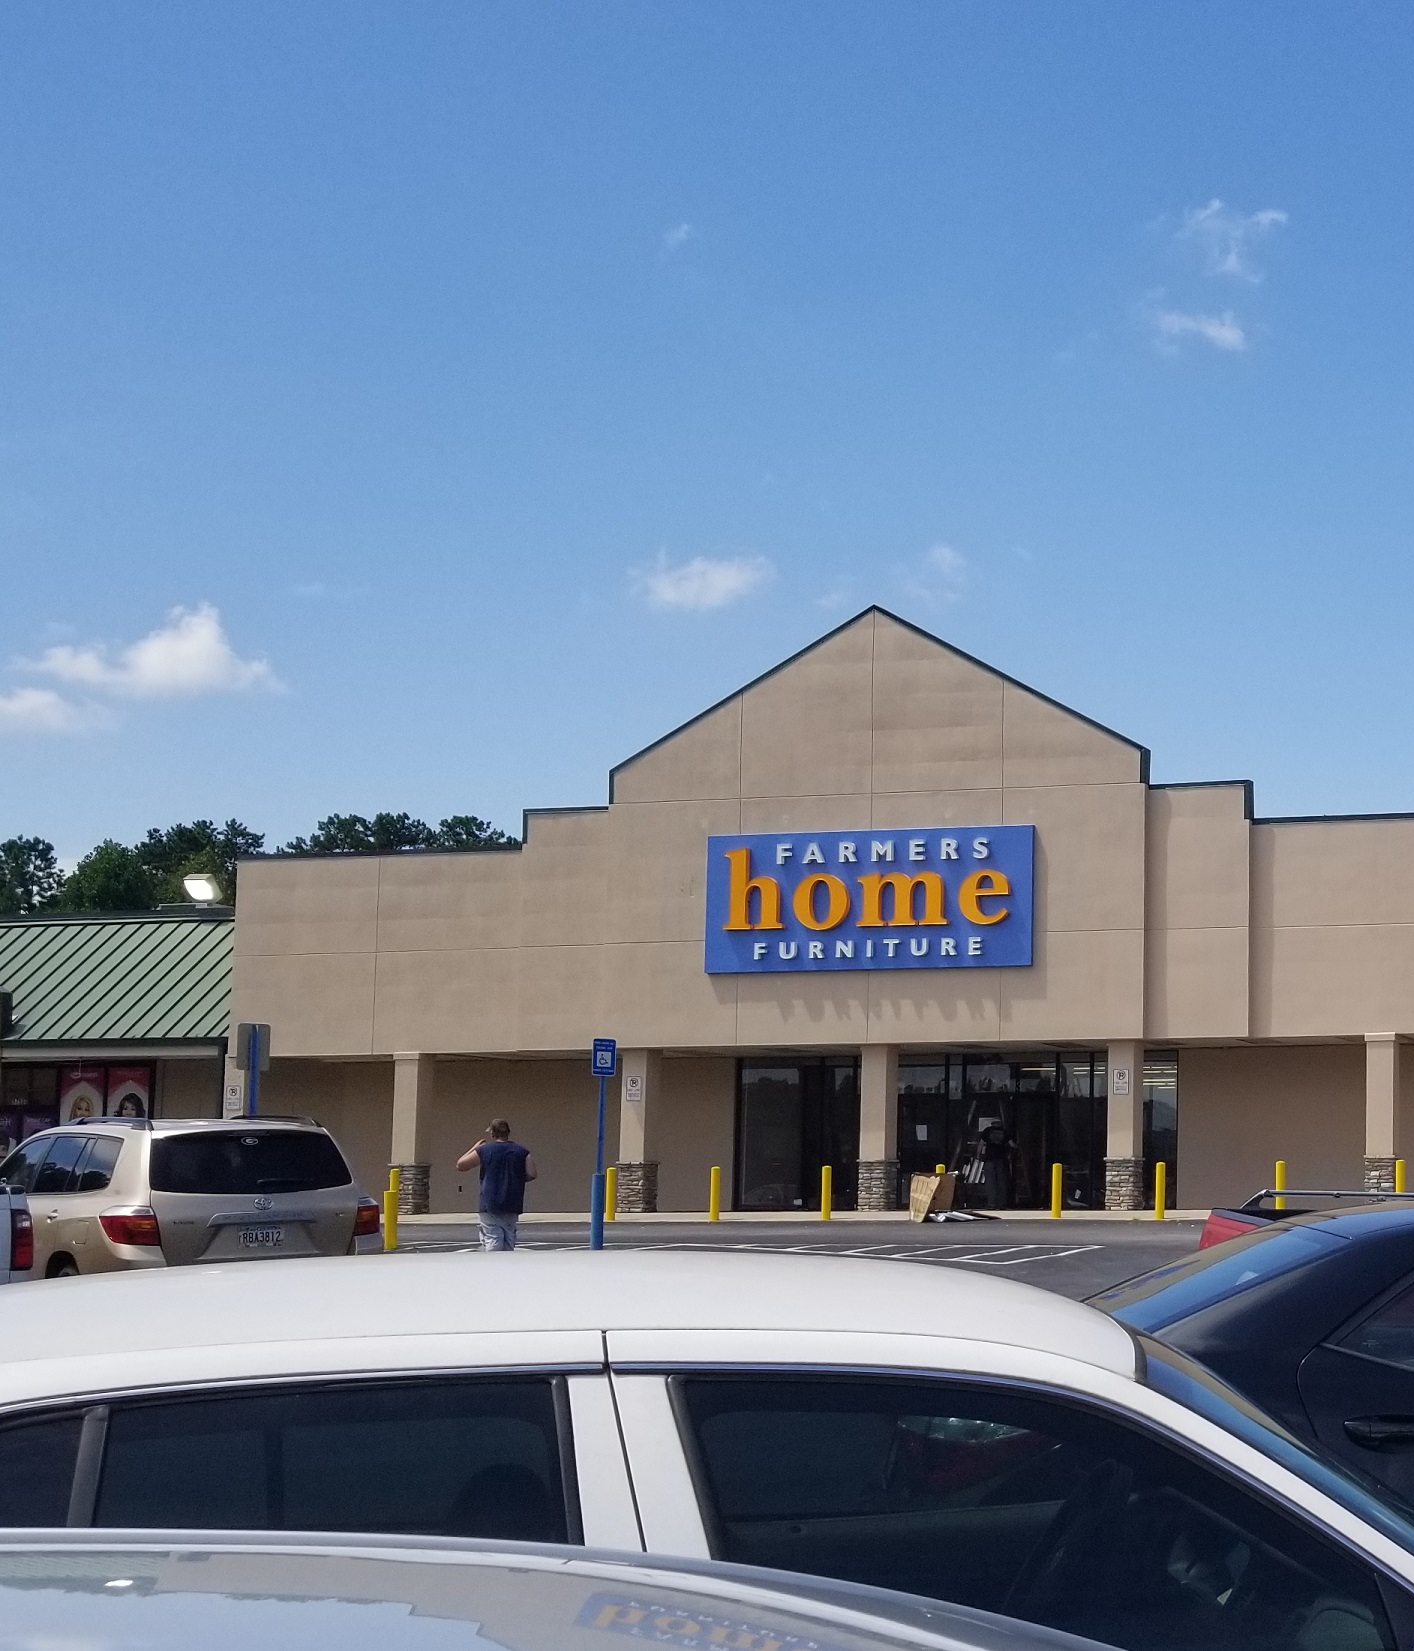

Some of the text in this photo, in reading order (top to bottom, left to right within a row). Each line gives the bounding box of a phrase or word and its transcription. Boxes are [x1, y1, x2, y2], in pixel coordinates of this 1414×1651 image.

[776, 837, 990, 865] FARMERS
[722, 847, 1011, 931] home
[753, 936, 984, 960] FURNITURE
[242, 1231, 281, 1243] RBA3812
